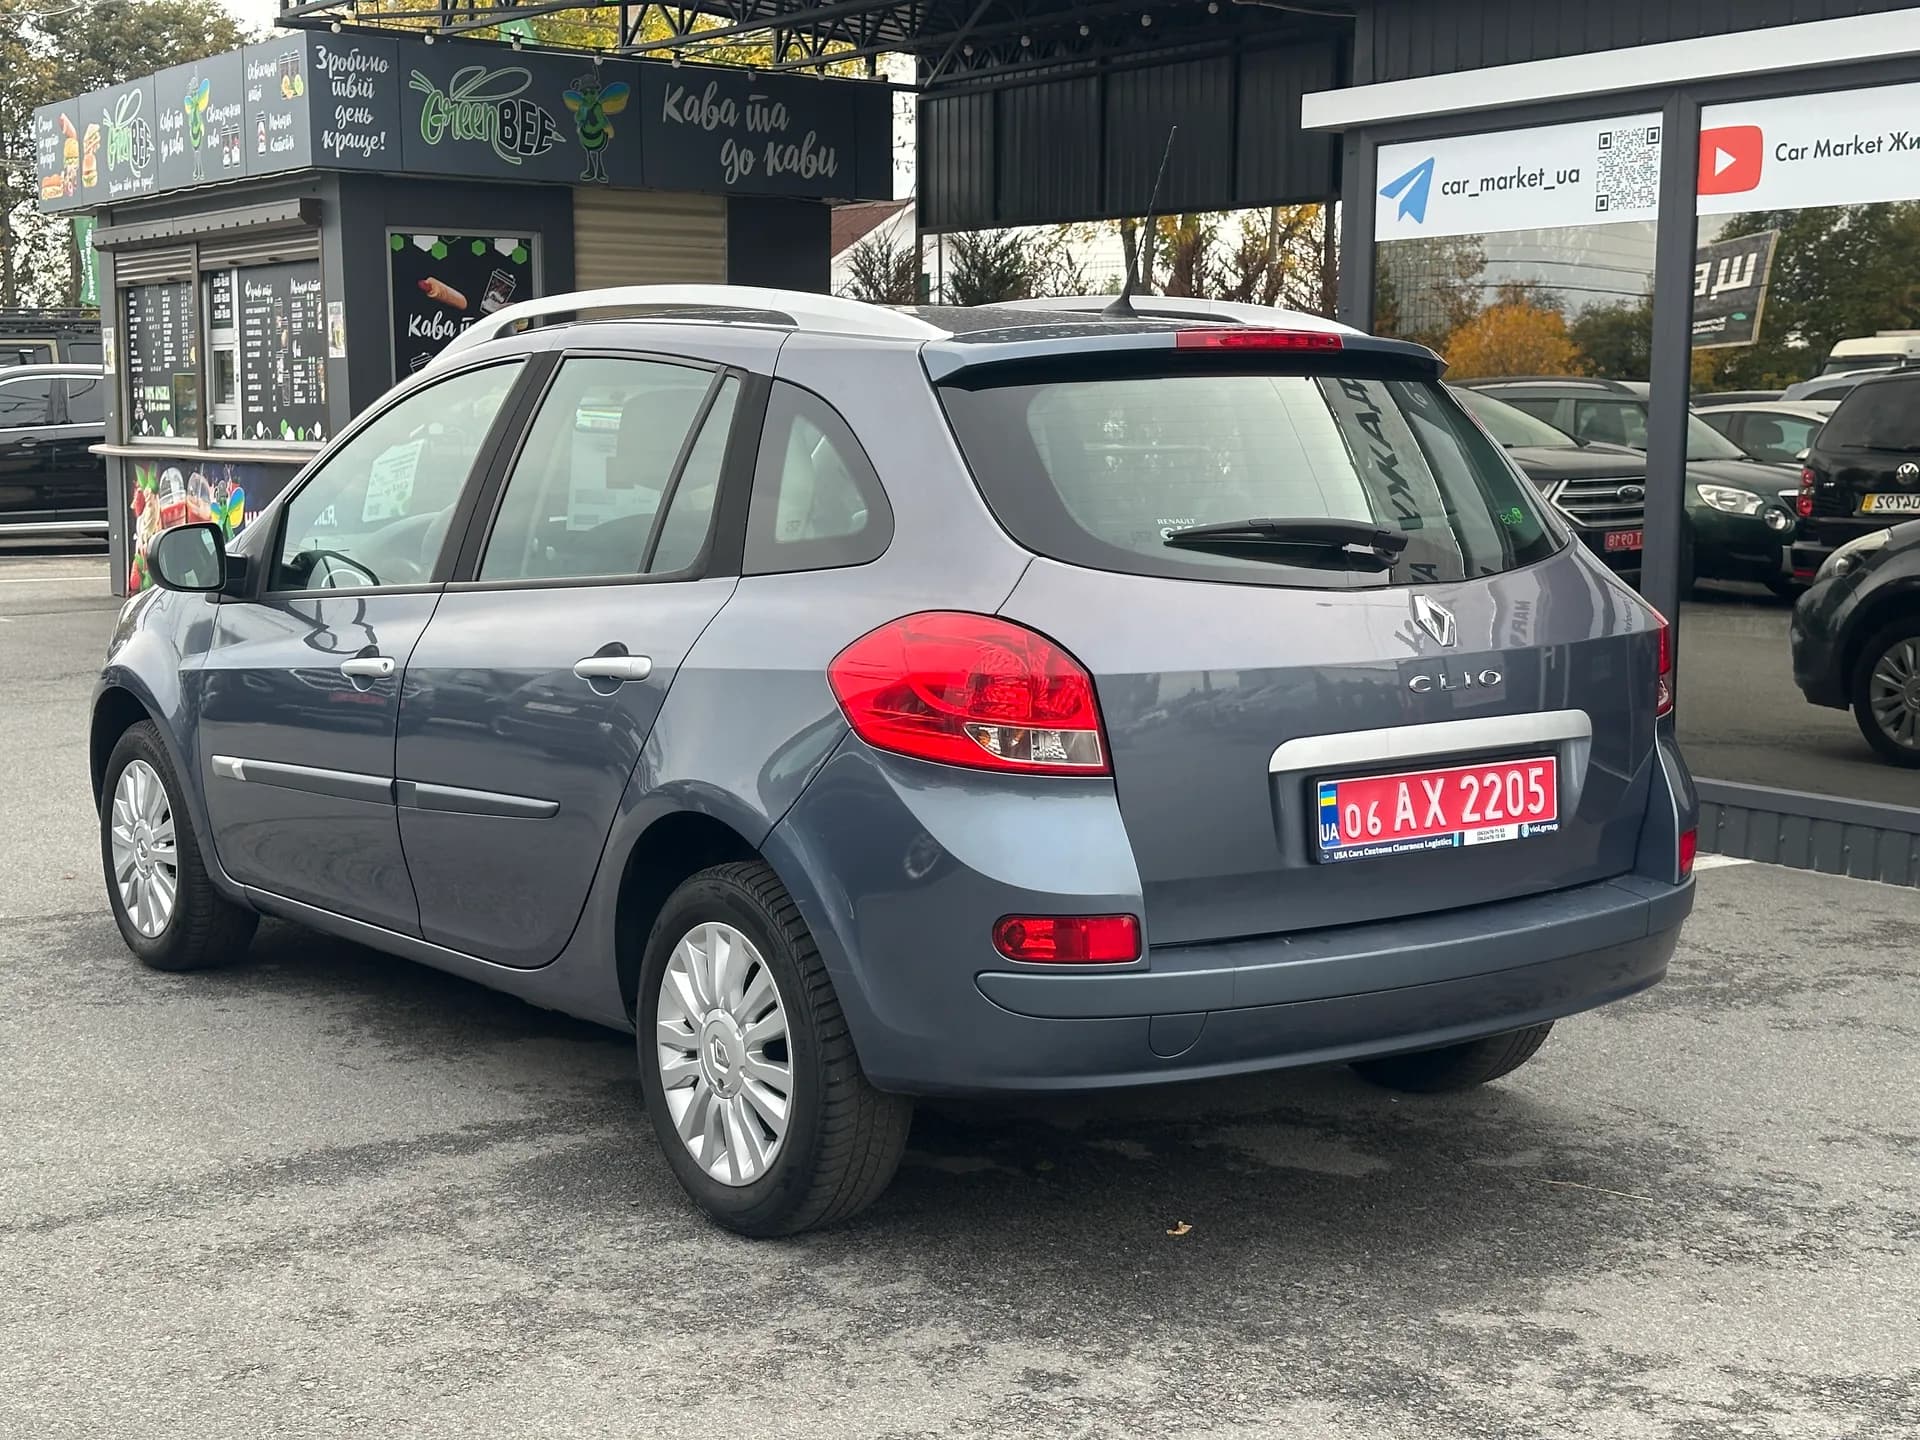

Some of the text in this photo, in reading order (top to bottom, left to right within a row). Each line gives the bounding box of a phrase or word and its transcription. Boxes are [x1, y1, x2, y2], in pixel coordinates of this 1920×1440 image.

[316, 45, 389, 79] Зробимо
[332, 75, 375, 98] твій
[335, 104, 373, 129] день
[663, 80, 789, 133] Кава та
[322, 131, 386, 158] краще!
[720, 130, 838, 184] до кави
[1775, 142, 1809, 162] Car
[1813, 134, 1883, 159] Market
[1441, 165, 1581, 198] car_market_ua
[407, 310, 456, 341] Кава
[1157, 518, 1195, 526] RENAULT
[1408, 669, 1502, 694] CLIO
[1344, 766, 1546, 838] 06 AX 2205
[1321, 823, 1339, 842] UA
[1333, 838, 1453, 860] USA Cars Customs Clearance Logistics
